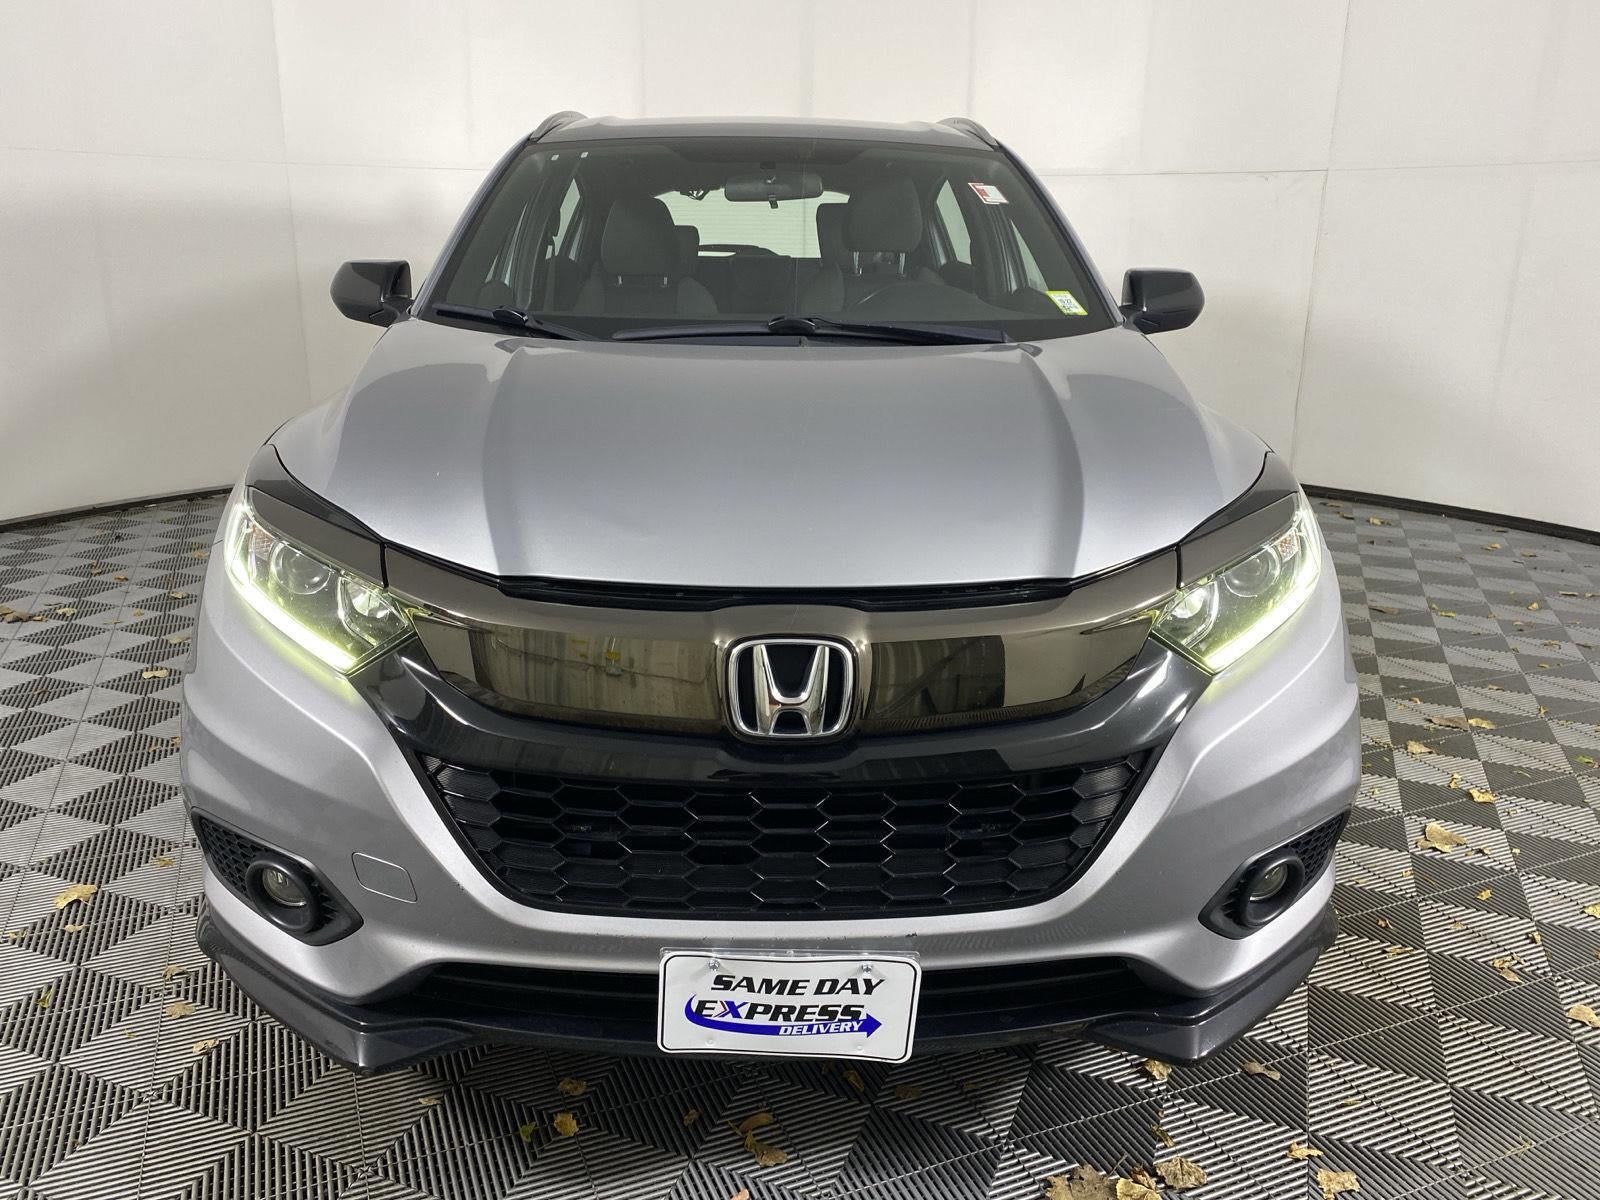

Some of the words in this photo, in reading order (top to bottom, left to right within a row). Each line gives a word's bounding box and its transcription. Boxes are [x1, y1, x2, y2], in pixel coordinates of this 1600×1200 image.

[711, 974, 810, 995] SAME
[813, 978, 885, 995] DAY
[694, 999, 864, 1022] EXPRESS
[779, 1020, 863, 1035] DELIVERY
